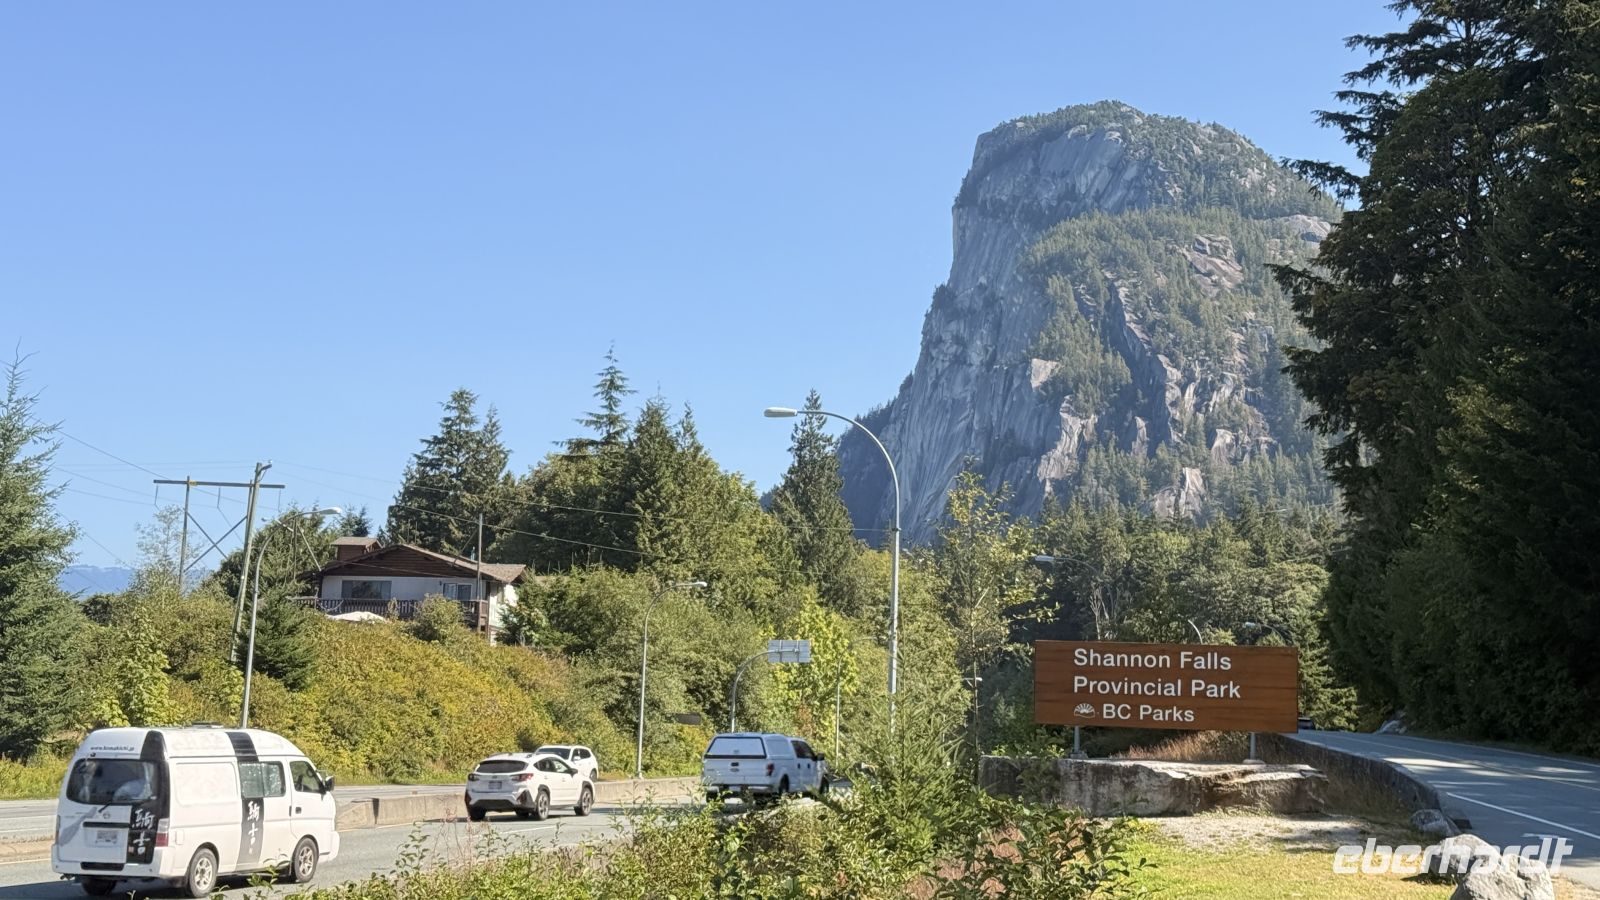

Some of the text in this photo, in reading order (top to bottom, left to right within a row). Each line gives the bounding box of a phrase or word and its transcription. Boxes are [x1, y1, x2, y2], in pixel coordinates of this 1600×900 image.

[1073, 648, 1232, 671] Shannon Falls
[1073, 676, 1241, 699] Provincial Park
[1102, 703, 1195, 722] BC Parks
